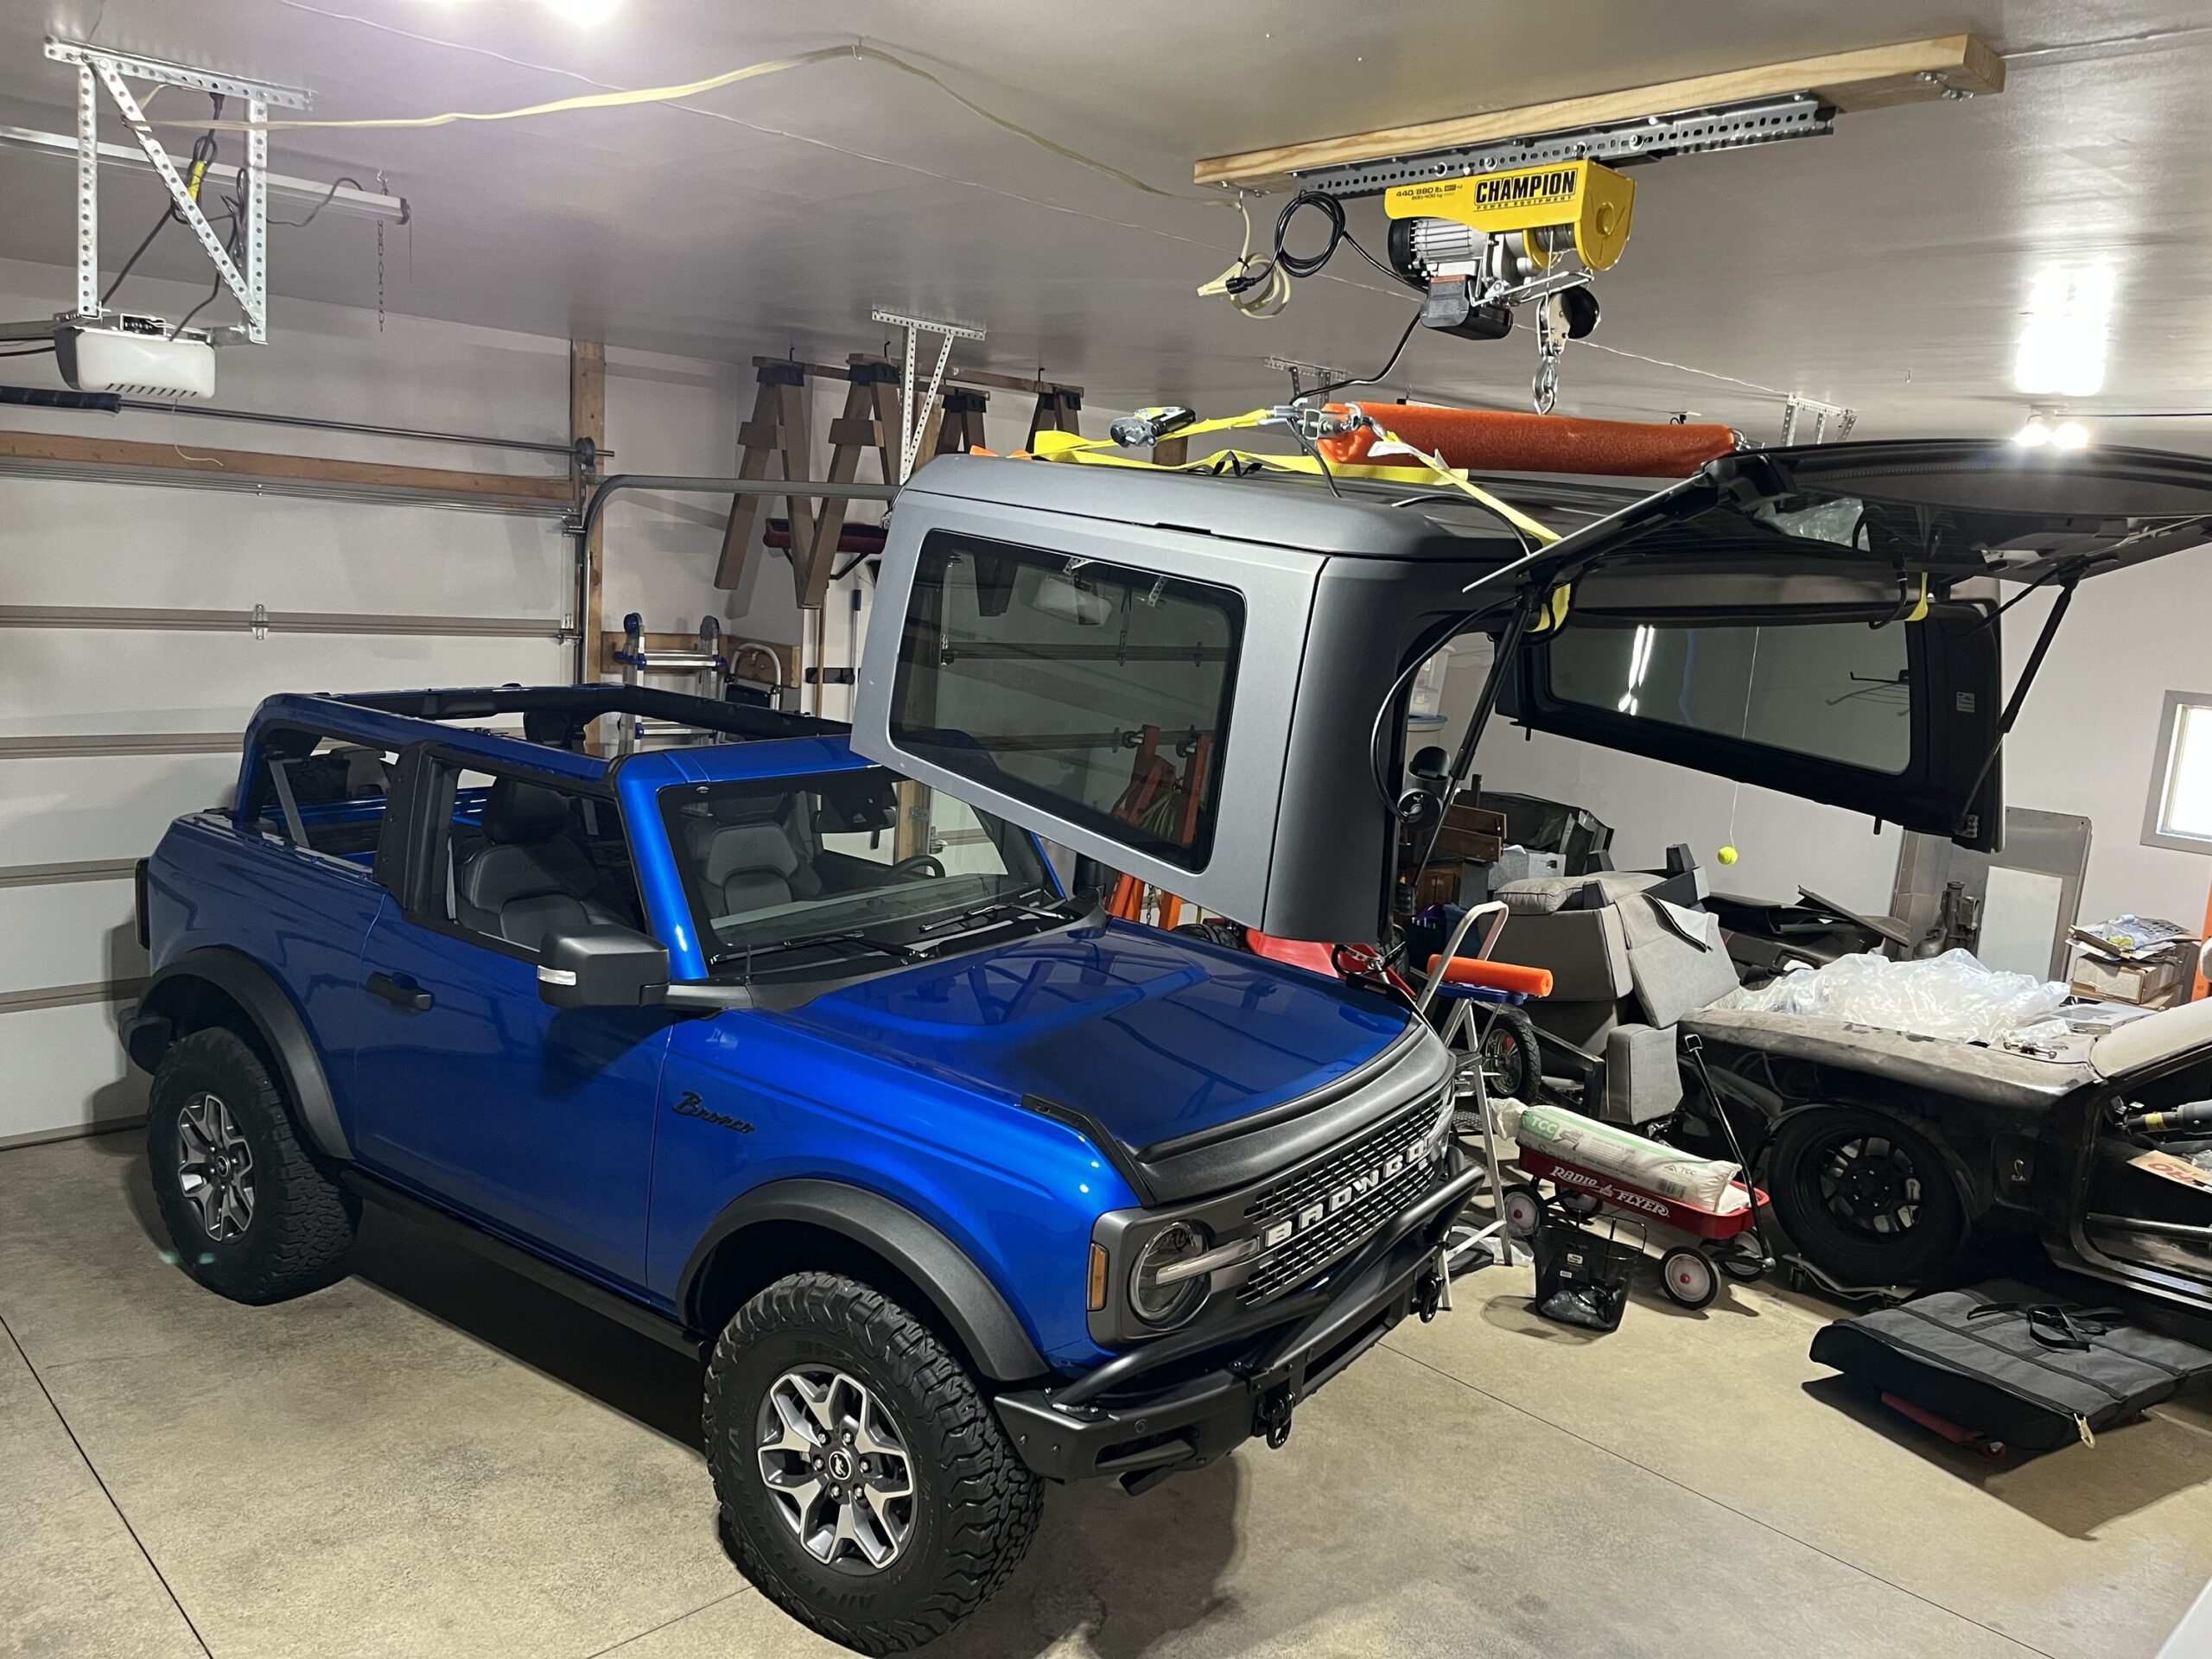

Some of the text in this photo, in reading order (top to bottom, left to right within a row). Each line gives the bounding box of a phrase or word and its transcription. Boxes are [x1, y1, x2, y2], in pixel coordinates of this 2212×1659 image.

[1476, 171, 1576, 204] CHAMPION
[1513, 195, 1572, 206] EQUIPMENT
[1530, 1117, 1558, 1134] TCC
[1681, 1166, 1696, 1176] TCC
[1265, 1139, 1425, 1248] BRONCO
[1549, 1166, 1669, 1217] RADIO FLYER
